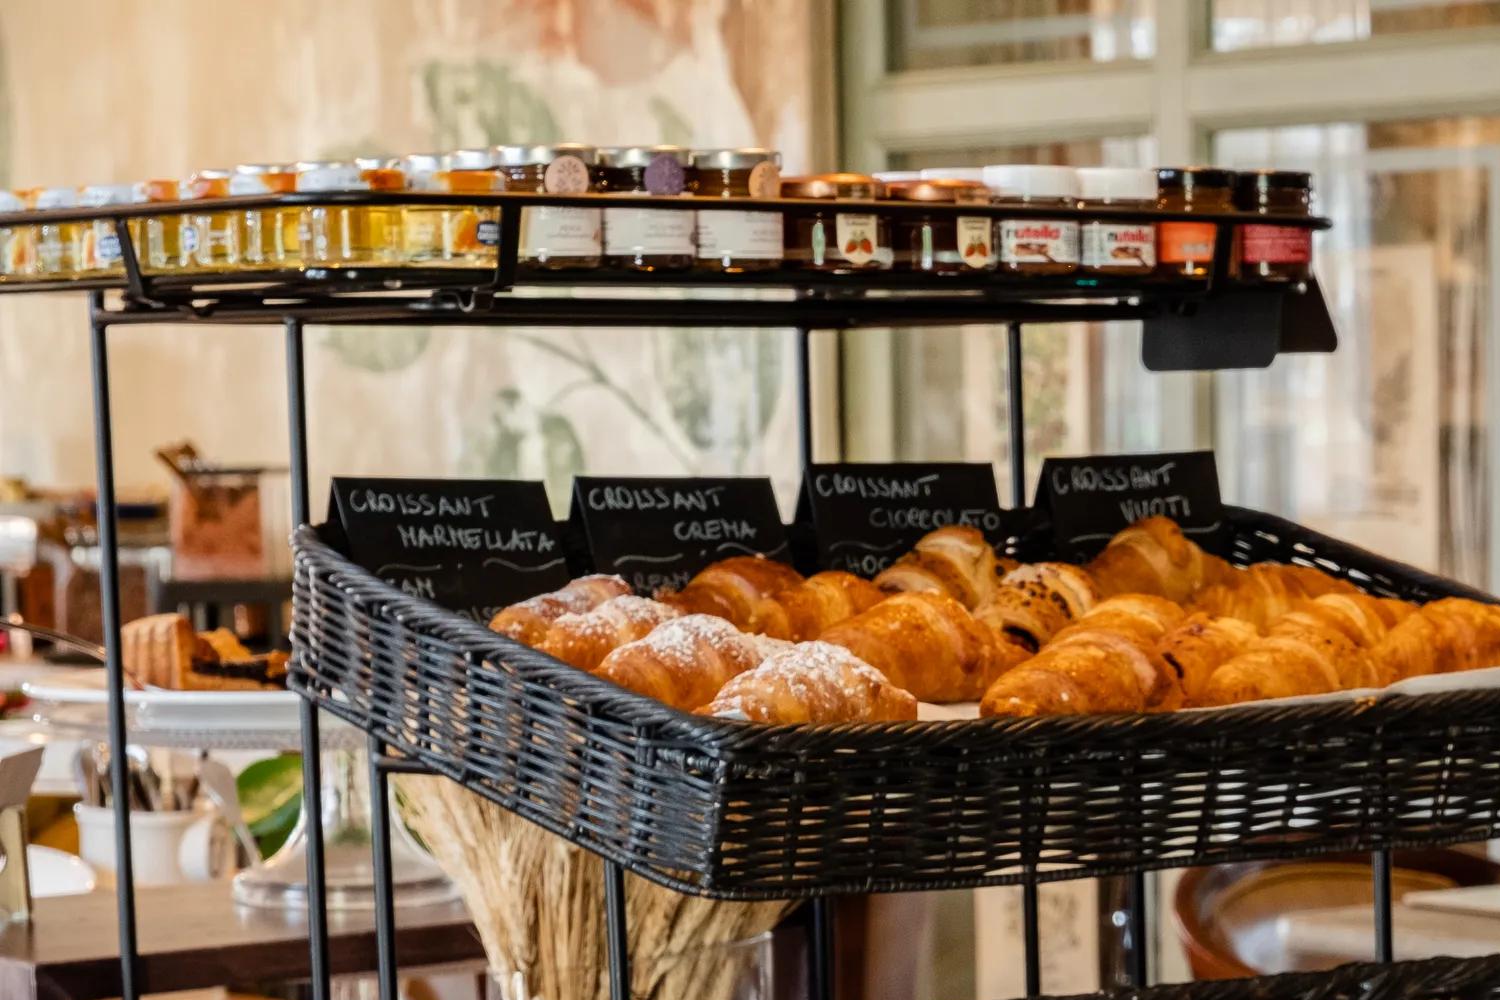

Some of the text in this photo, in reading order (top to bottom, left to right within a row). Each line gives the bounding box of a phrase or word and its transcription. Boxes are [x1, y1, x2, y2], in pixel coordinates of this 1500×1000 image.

[588, 486, 726, 512] CROISSANT
[816, 473, 940, 499] CROISSANT
[350, 489, 495, 517] CROISSANT
[1120, 495, 1191, 524] VUOTI
[673, 518, 757, 541] CREMA
